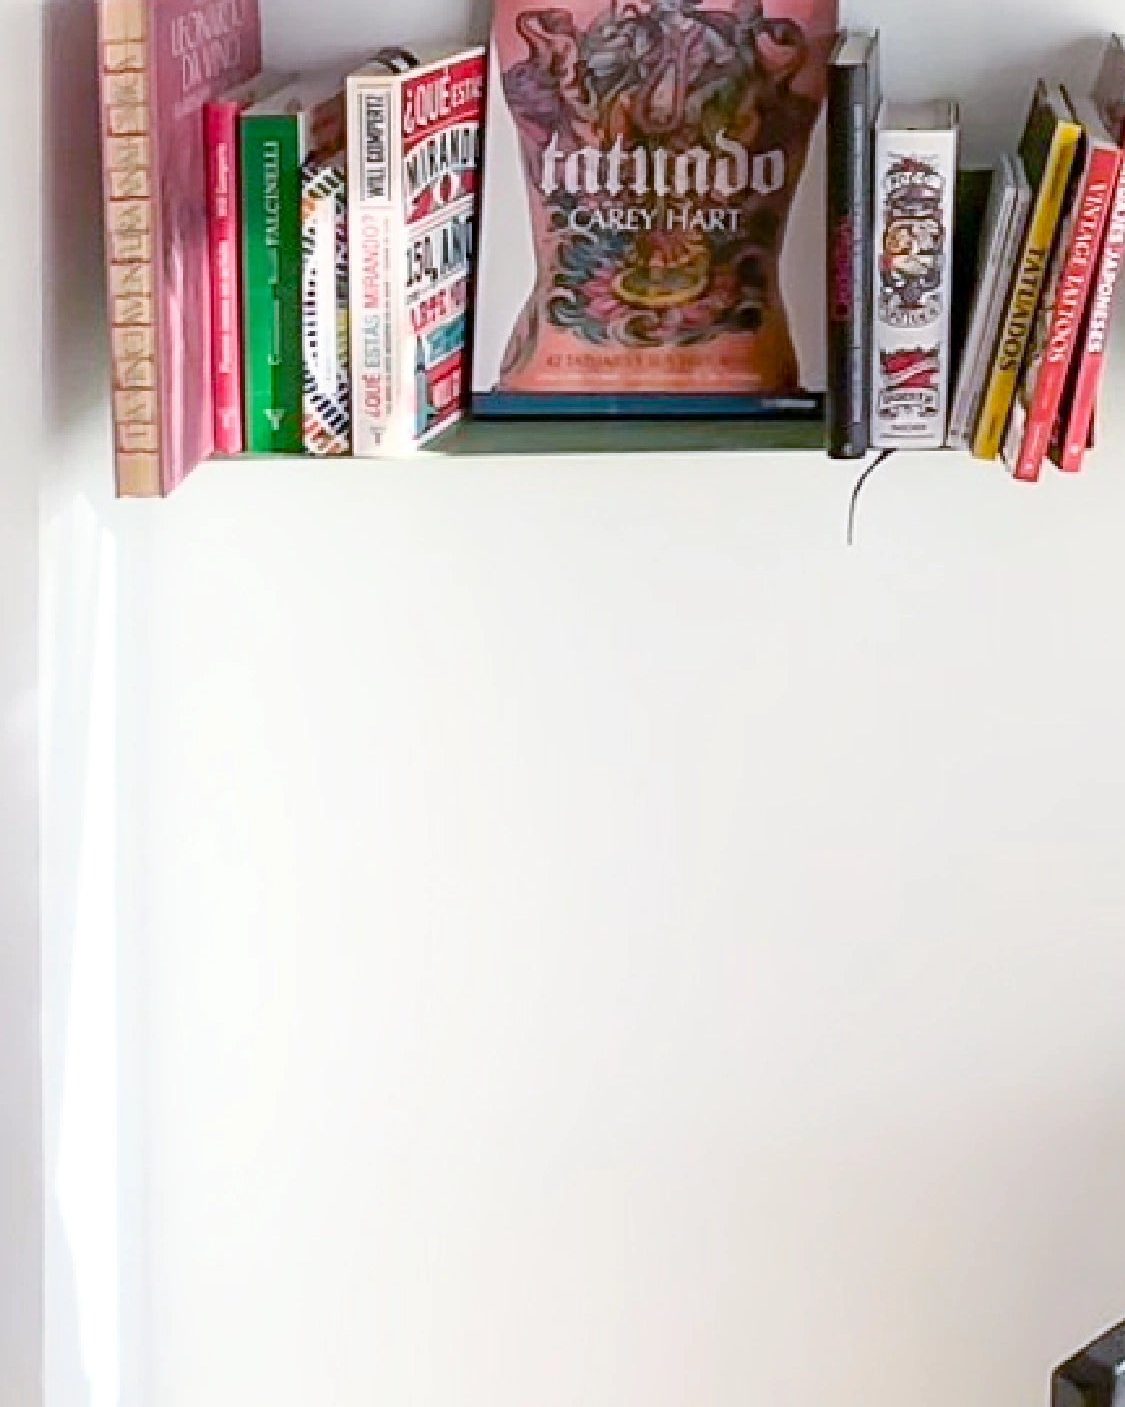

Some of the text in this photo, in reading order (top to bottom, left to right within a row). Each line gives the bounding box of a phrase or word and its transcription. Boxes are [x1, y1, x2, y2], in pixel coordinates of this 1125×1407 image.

[263, 140, 280, 246] FALCINELLI
[569, 207, 743, 232] CAREY HART
